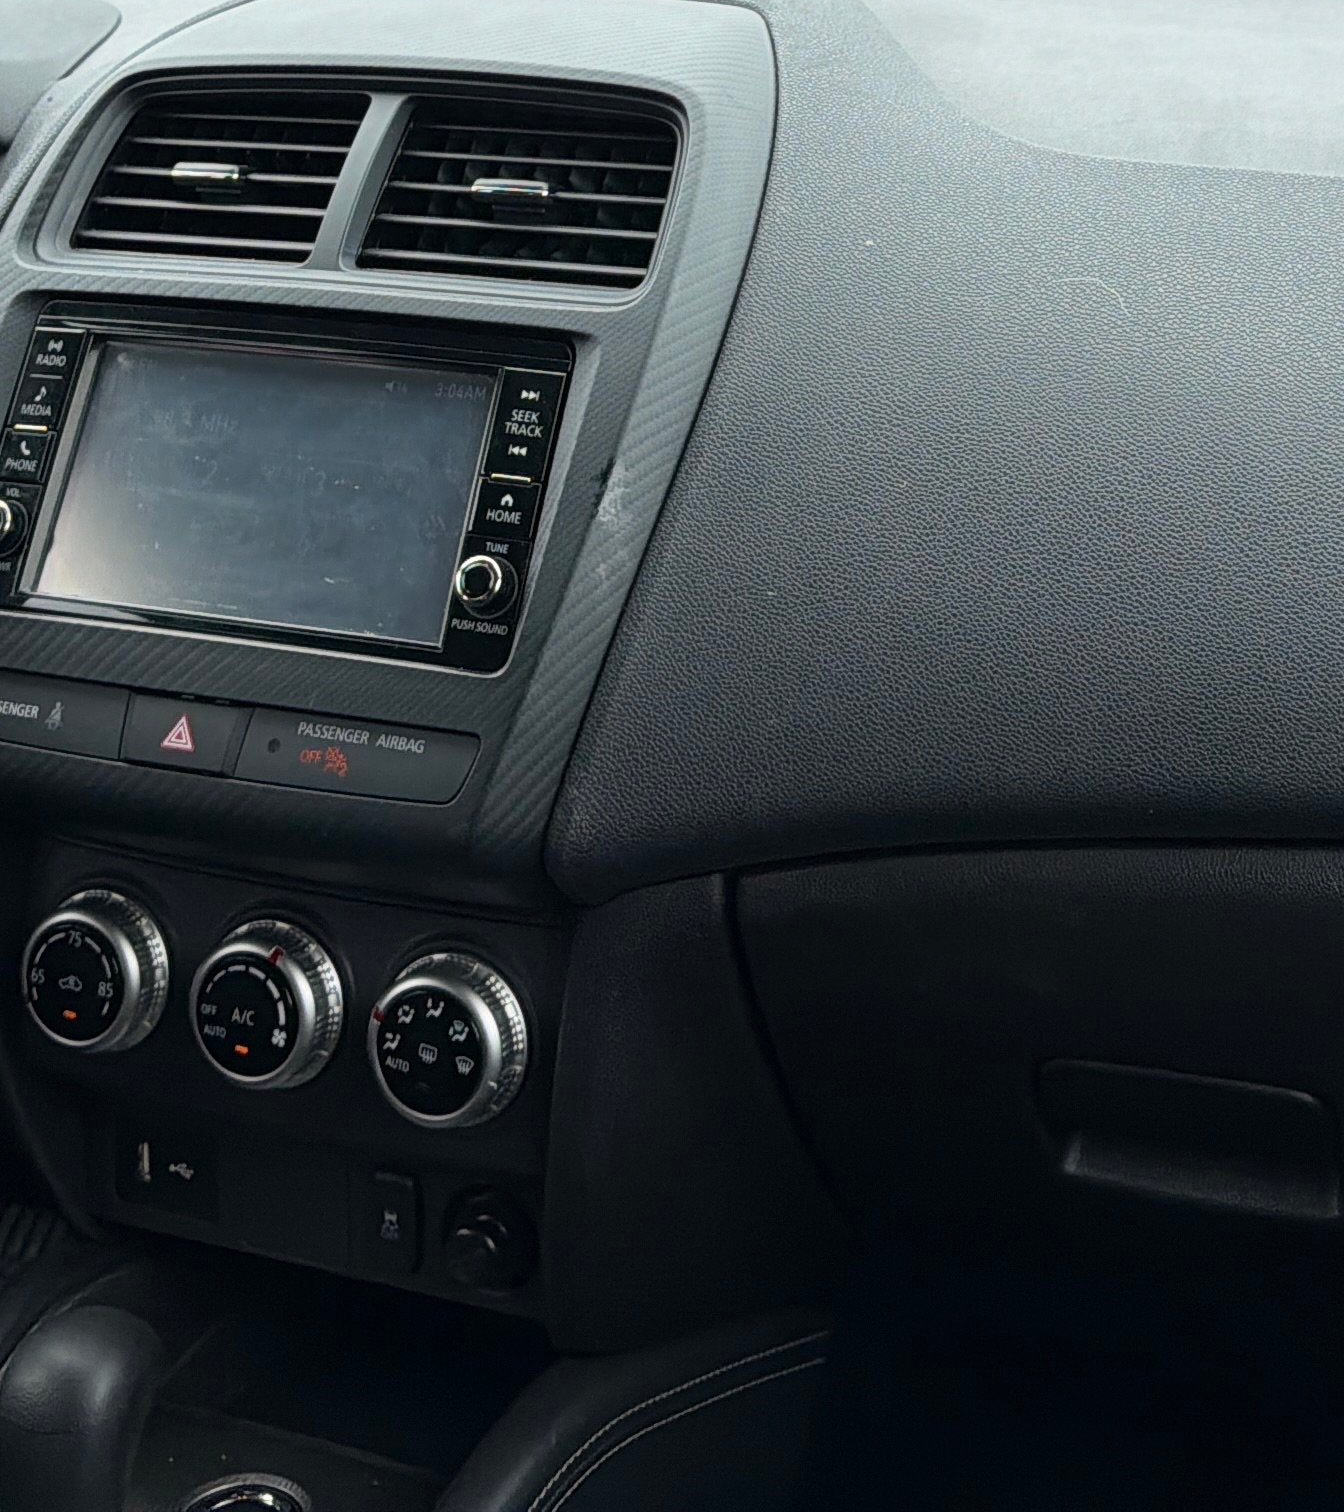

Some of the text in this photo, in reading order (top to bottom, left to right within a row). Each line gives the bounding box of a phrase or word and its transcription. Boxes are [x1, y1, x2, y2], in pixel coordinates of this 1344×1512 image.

[36, 353, 67, 367] RADIO
[21, 403, 52, 417] MEDIA
[511, 408, 540, 424] SEEK
[504, 421, 544, 438] TRACK
[5, 457, 38, 473] PHONE
[486, 508, 522, 525] HOME
[485, 541, 510, 554] TUNE
[451, 618, 509, 636] PUSH SOUND
[297, 721, 426, 755] PASSENGER AIRBAG
[299, 749, 322, 764] OFF
[67, 930, 83, 948] 75
[31, 967, 45, 984] 65
[97, 981, 114, 998] 85
[200, 1003, 218, 1016] OFF
[231, 1006, 256, 1027] A/C
[203, 1023, 227, 1039] AUTO
[384, 1055, 410, 1073] AUTO
